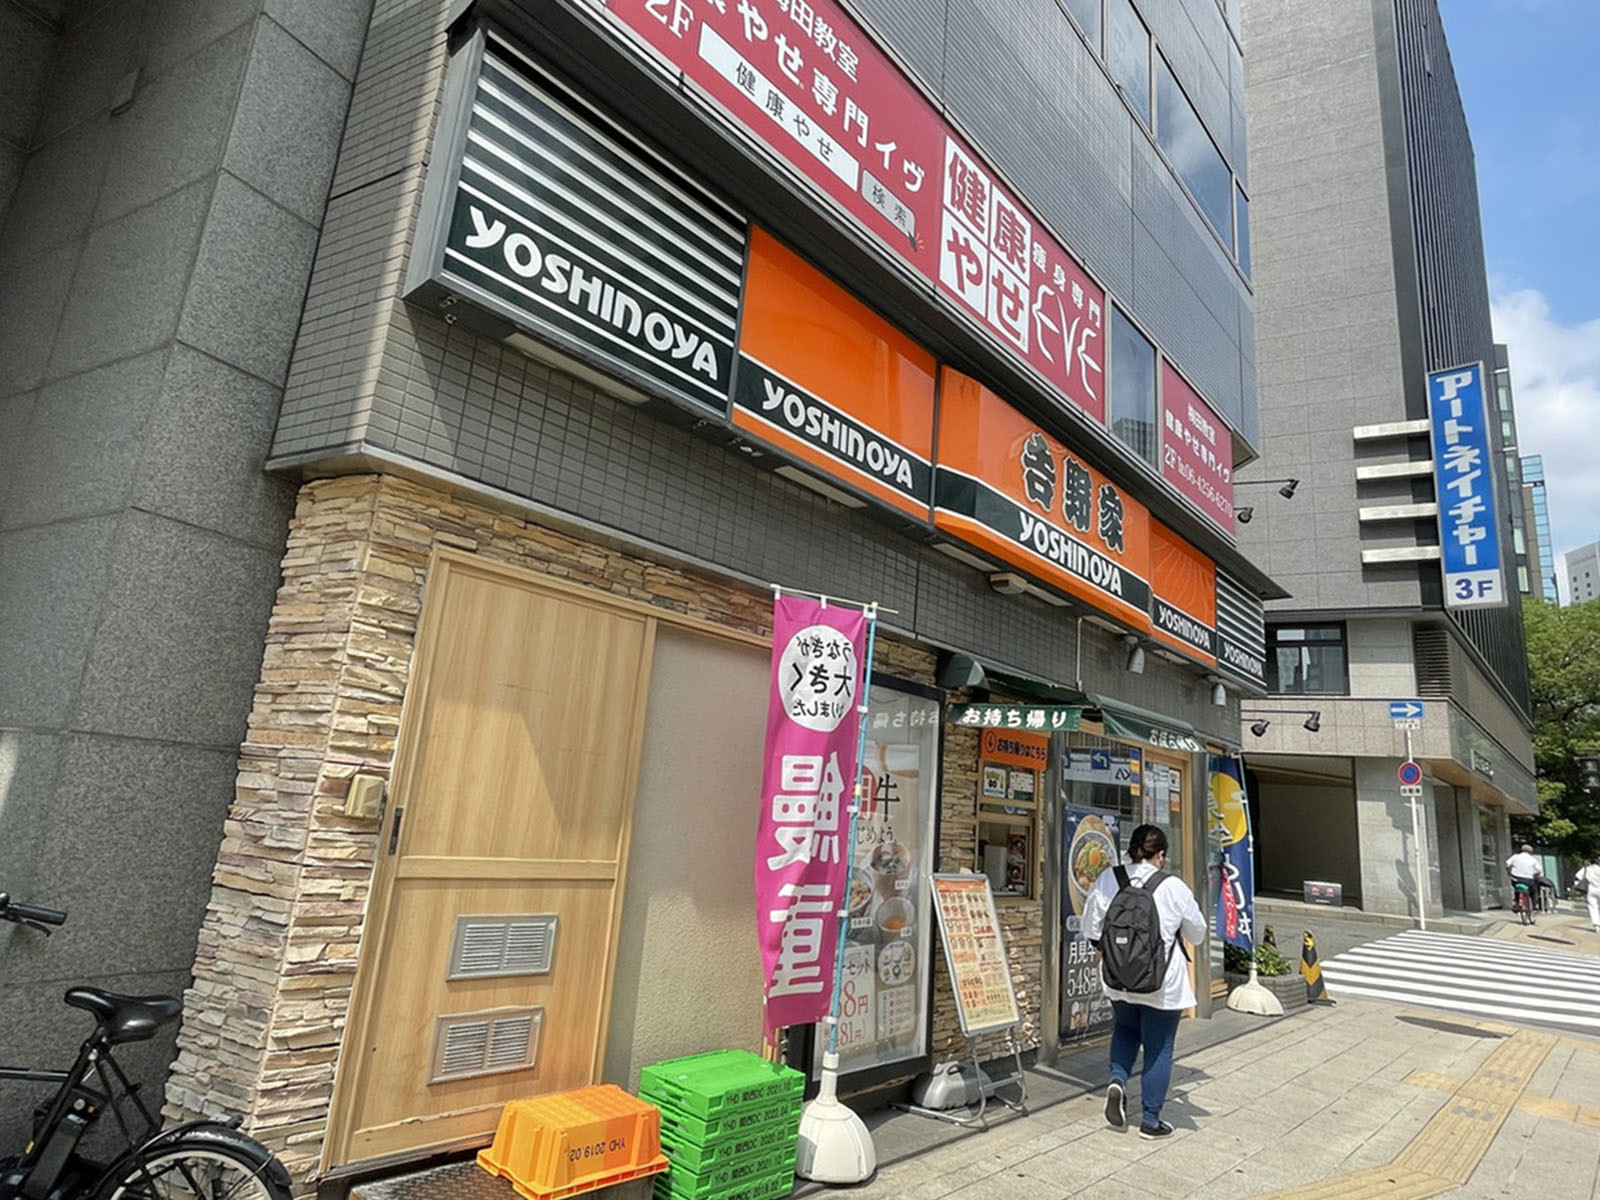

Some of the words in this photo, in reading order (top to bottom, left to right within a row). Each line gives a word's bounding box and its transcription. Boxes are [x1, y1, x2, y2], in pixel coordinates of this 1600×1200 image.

[776, 0, 859, 84] 田教室
[736, 61, 834, 164] 健康やせ
[949, 151, 1027, 276] 健康
[465, 205, 719, 381] YOSHINOYA
[947, 226, 1024, 344] やせ
[762, 378, 913, 490] YOSHINOYA
[1436, 371, 1486, 566] アートネイチャー
[1020, 432, 1125, 556] 吉野家
[1018, 510, 1123, 596] YOSHINOYA
[1455, 578, 1494, 600] 3F
[1158, 605, 1211, 650] YOSHINOYA
[1223, 641, 1263, 678] YOSHINOYA
[961, 707, 1067, 729] お持ち帰り
